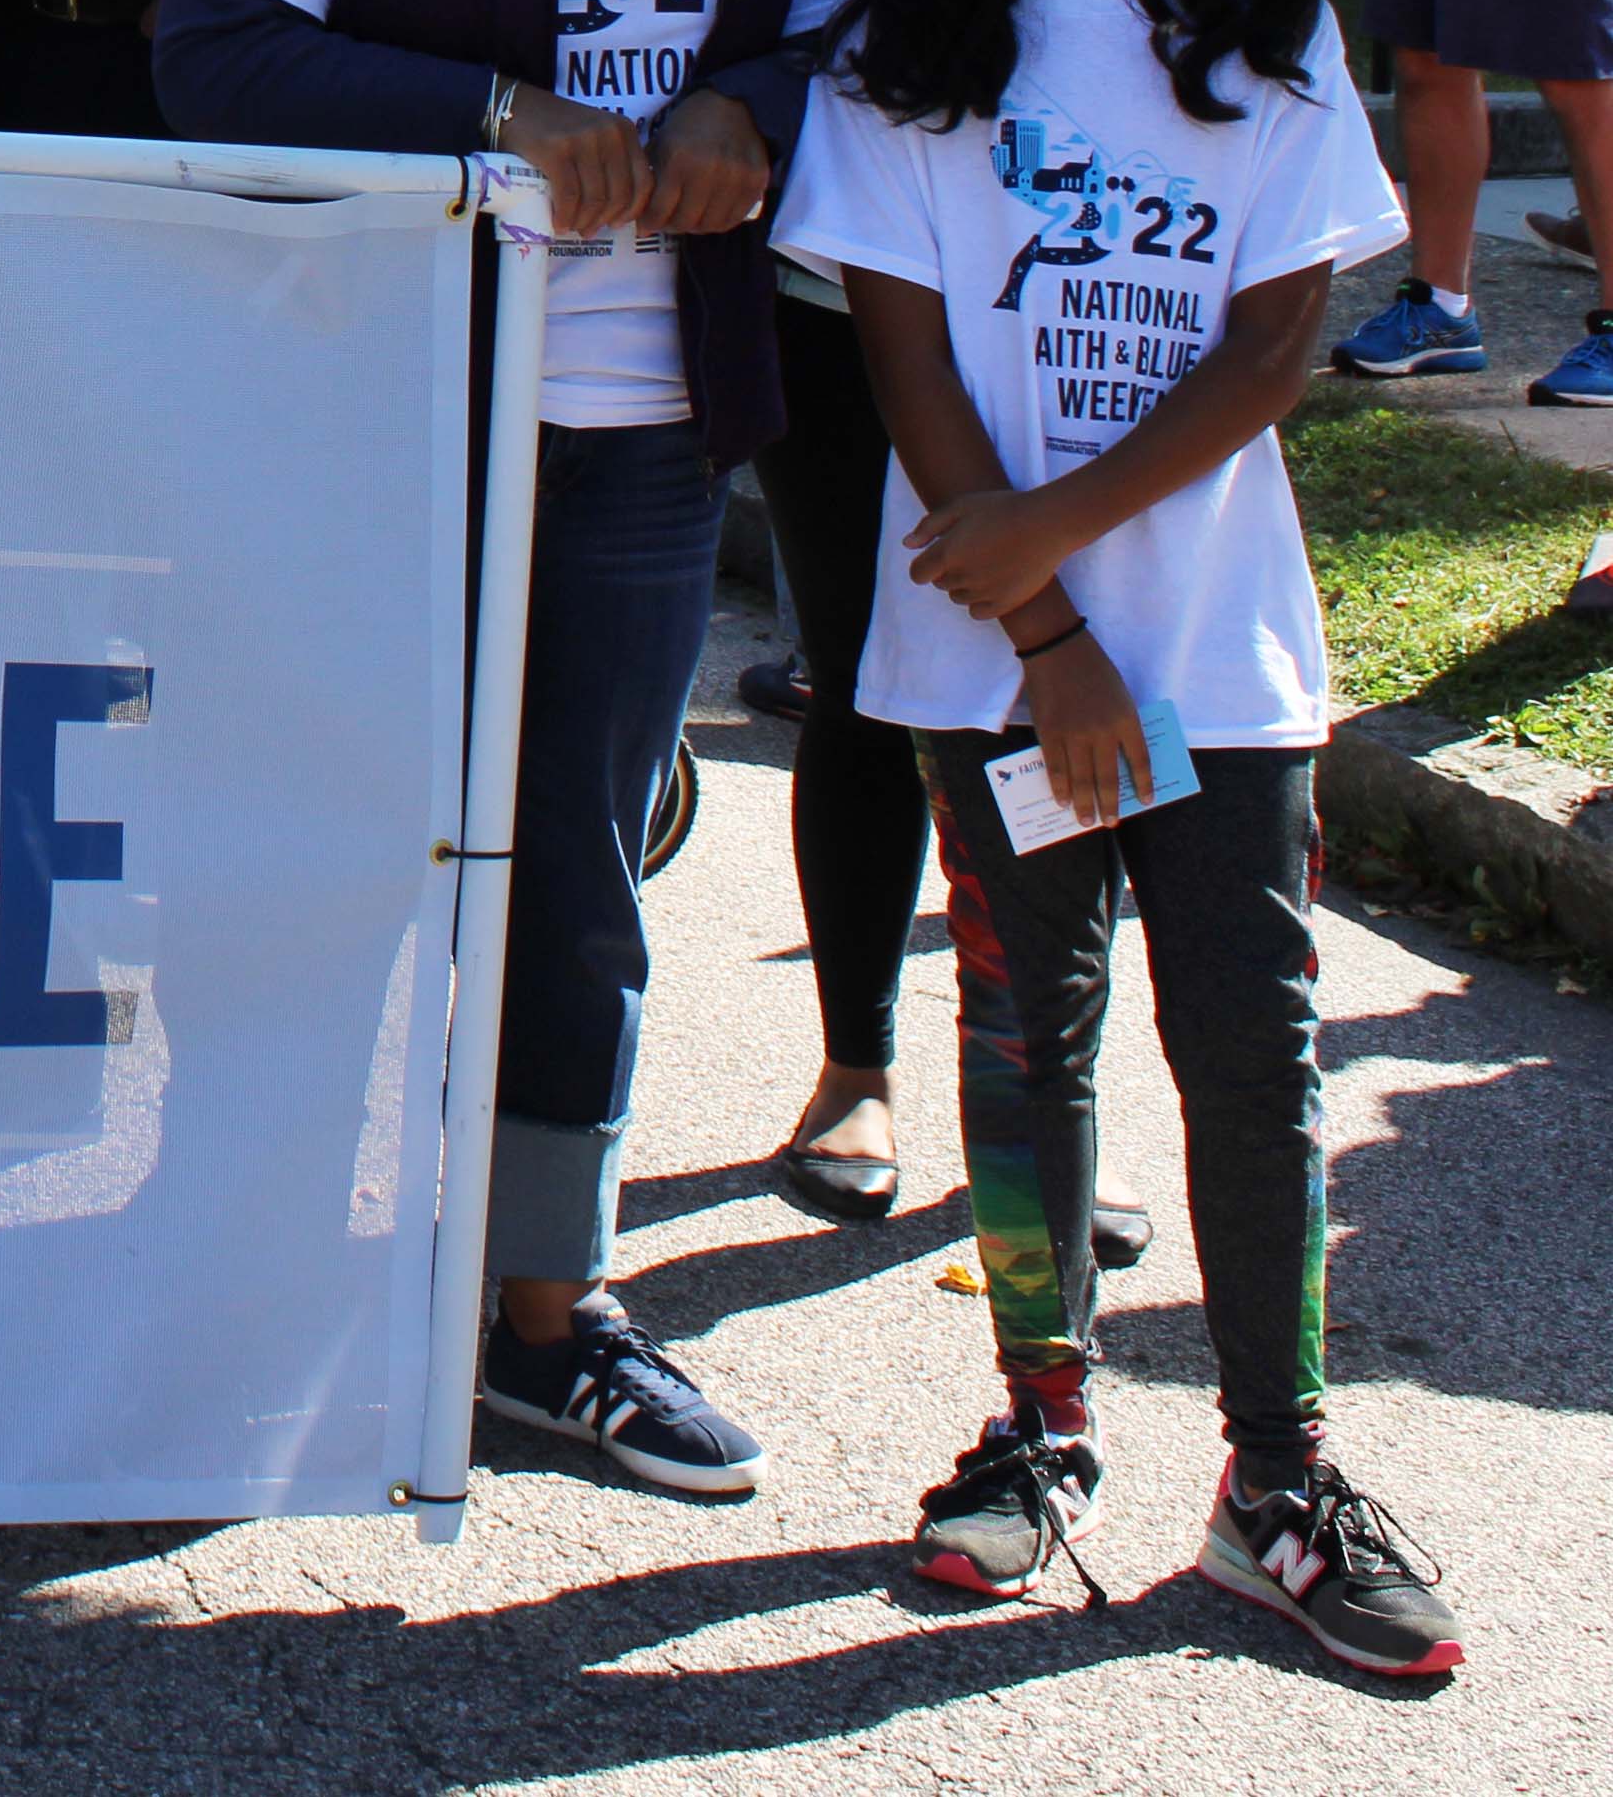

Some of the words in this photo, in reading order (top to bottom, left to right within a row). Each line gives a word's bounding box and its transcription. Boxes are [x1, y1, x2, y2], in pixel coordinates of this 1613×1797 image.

[548, 246, 613, 257] FOUNDATION
[1061, 279, 1204, 333] NATIONAL
[1114, 339, 1130, 365] &
[1135, 335, 1201, 381] BLUE
